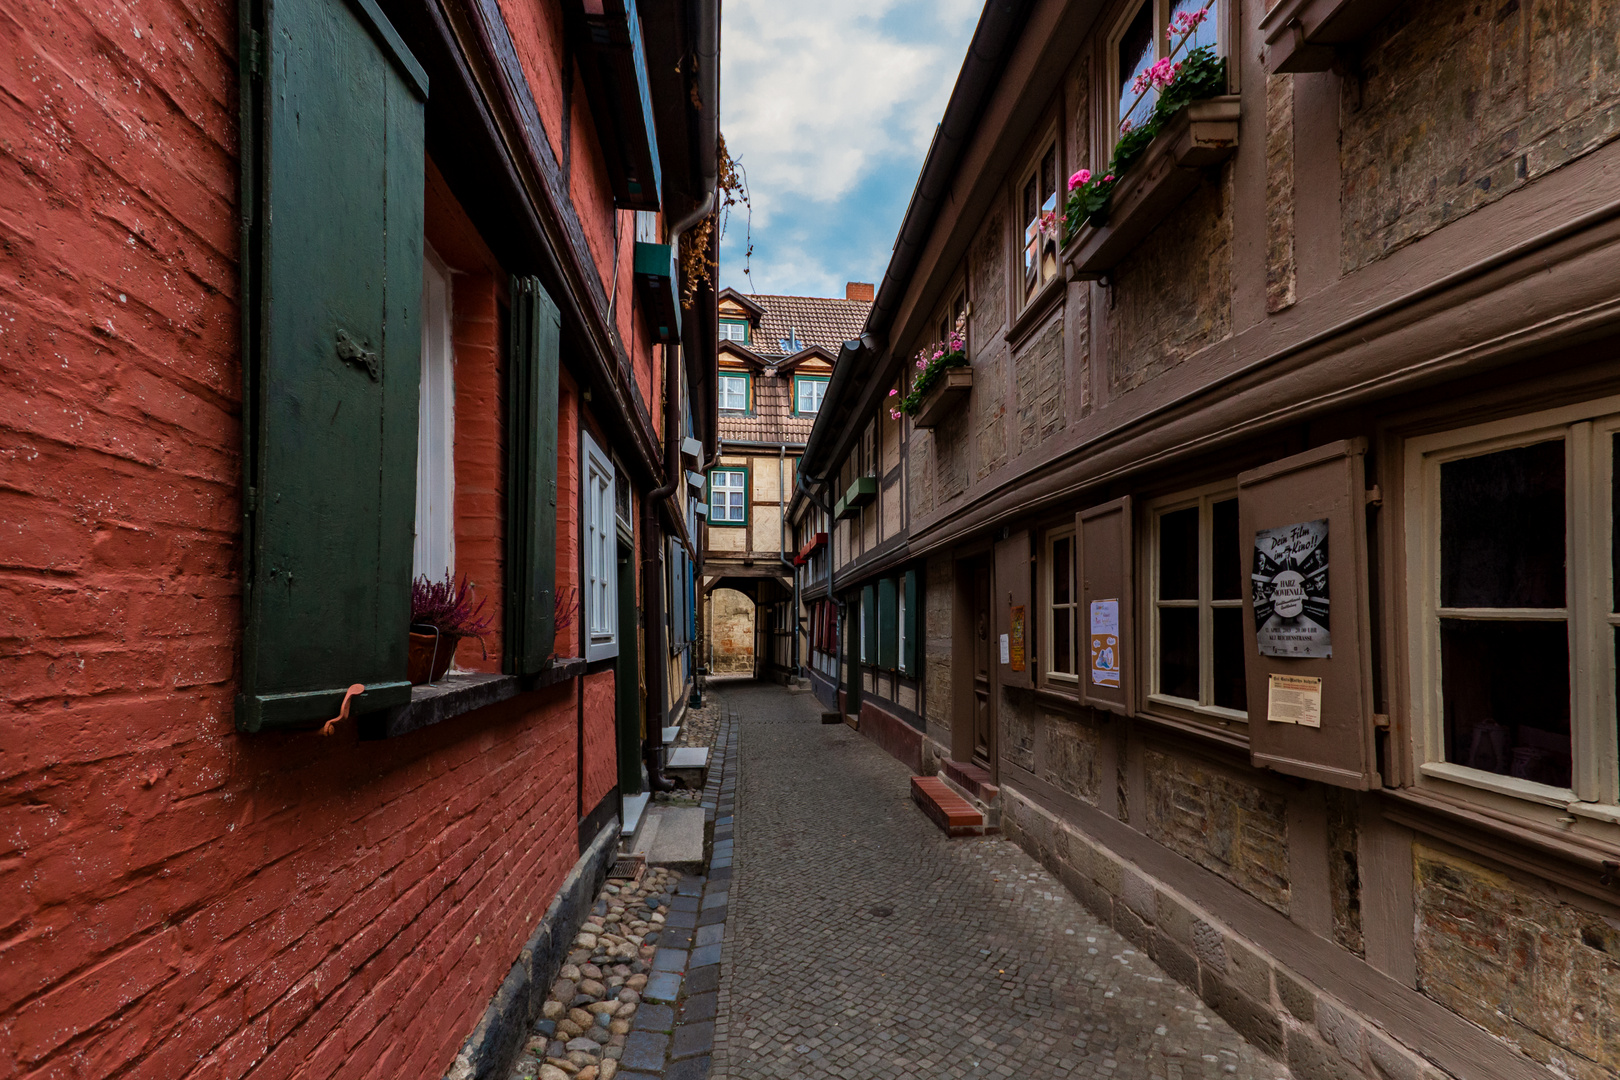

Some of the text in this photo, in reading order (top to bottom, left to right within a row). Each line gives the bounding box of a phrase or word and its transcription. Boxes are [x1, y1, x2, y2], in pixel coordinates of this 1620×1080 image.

[1271, 534, 1287, 550] Dein
[1290, 525, 1310, 542] Film
[1274, 535, 1318, 560] im Kino!!
[1274, 587, 1304, 597] MOVIENALE
[1280, 580, 1296, 588] HARZ
